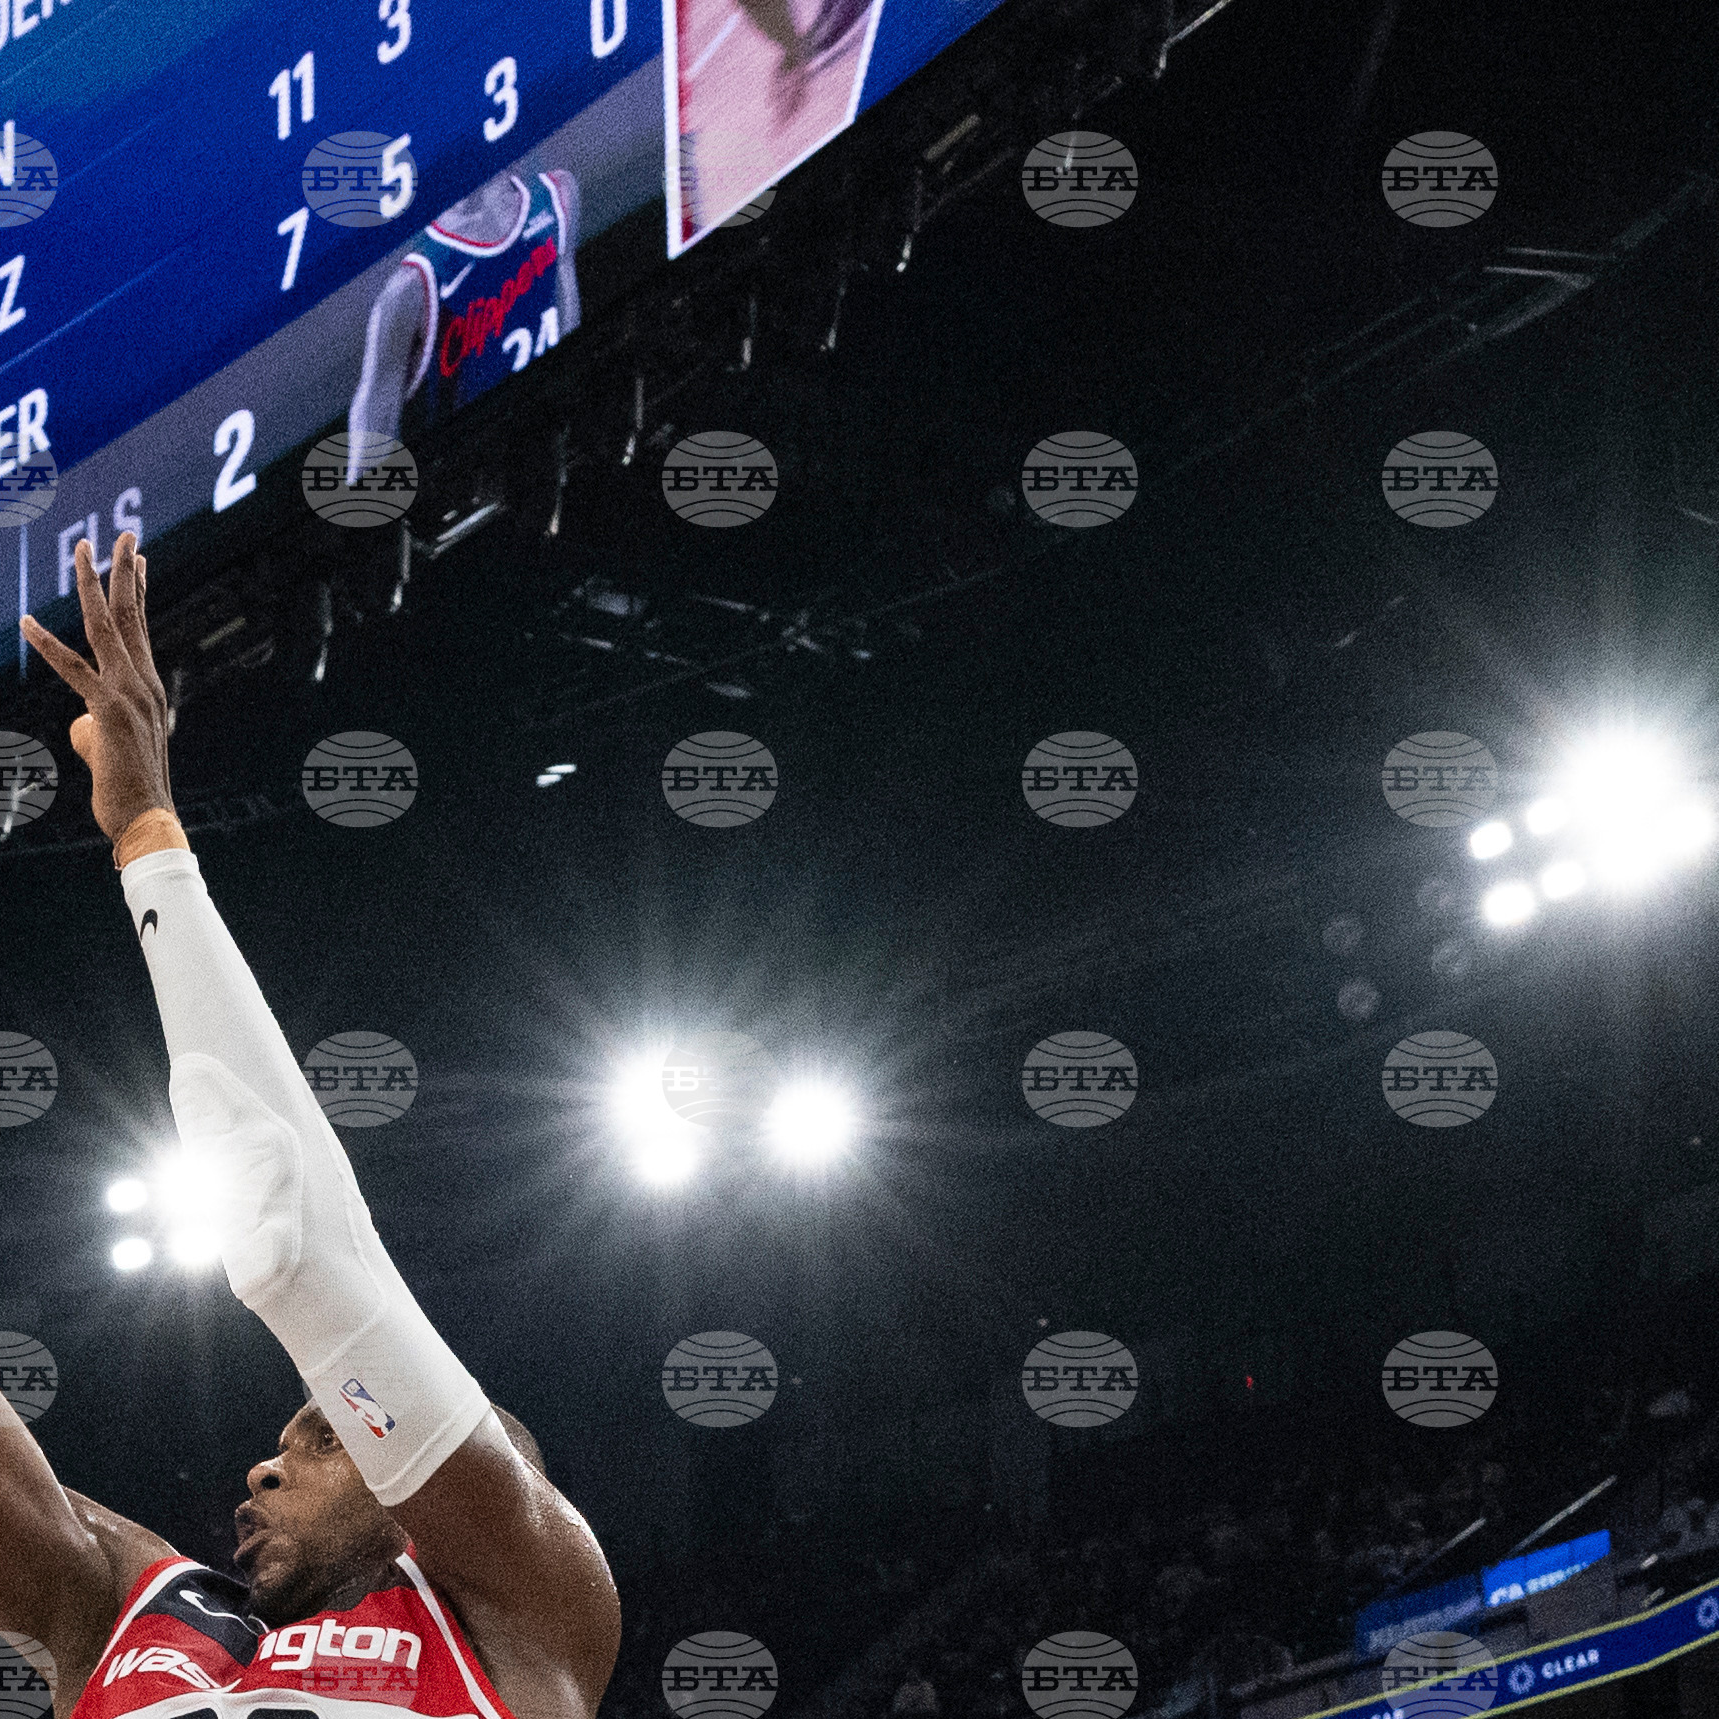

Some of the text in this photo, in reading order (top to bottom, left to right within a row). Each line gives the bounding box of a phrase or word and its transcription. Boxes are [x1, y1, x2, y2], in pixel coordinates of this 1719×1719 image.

[268, 50, 315, 140] 11
[483, 56, 519, 142] 3
[380, 133, 412, 219] 5
[277, 206, 309, 291] 7
[213, 409, 257, 513] 2
[1542, 1649, 1600, 1680] CLEAR
